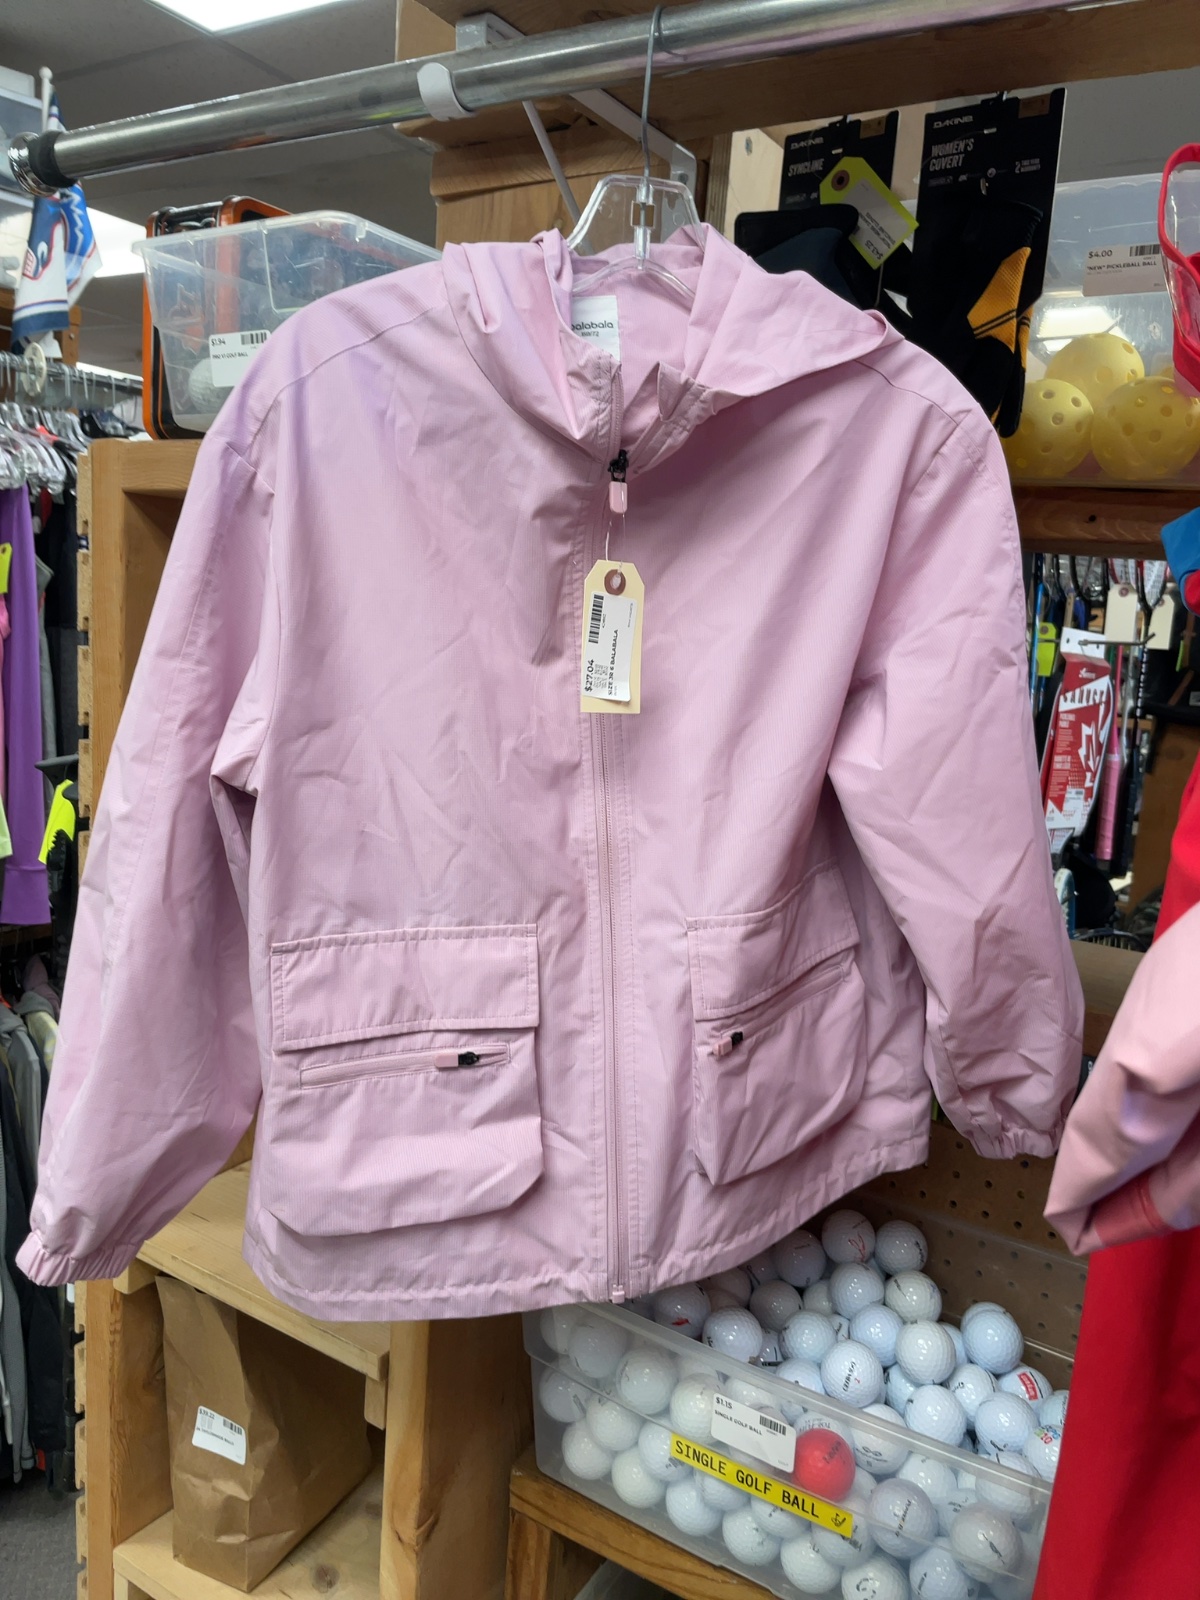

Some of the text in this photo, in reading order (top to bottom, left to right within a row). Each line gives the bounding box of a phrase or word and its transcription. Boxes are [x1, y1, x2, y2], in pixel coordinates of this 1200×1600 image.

[933, 115, 974, 129] DAKINE
[931, 138, 974, 157] WOMEN'S
[929, 154, 966, 172] COVERT
[1088, 250, 1113, 259] $4.00
[610, 629, 618, 665] BALABALA
[585, 658, 594, 692] $27.04
[716, 1396, 733, 1409] $1.15
[714, 1409, 733, 1422] SINGLE
[734, 1418, 748, 1428] GOLF
[749, 1424, 763, 1435] BALL
[675, 1440, 820, 1519] SINGLE GOLF BALL
